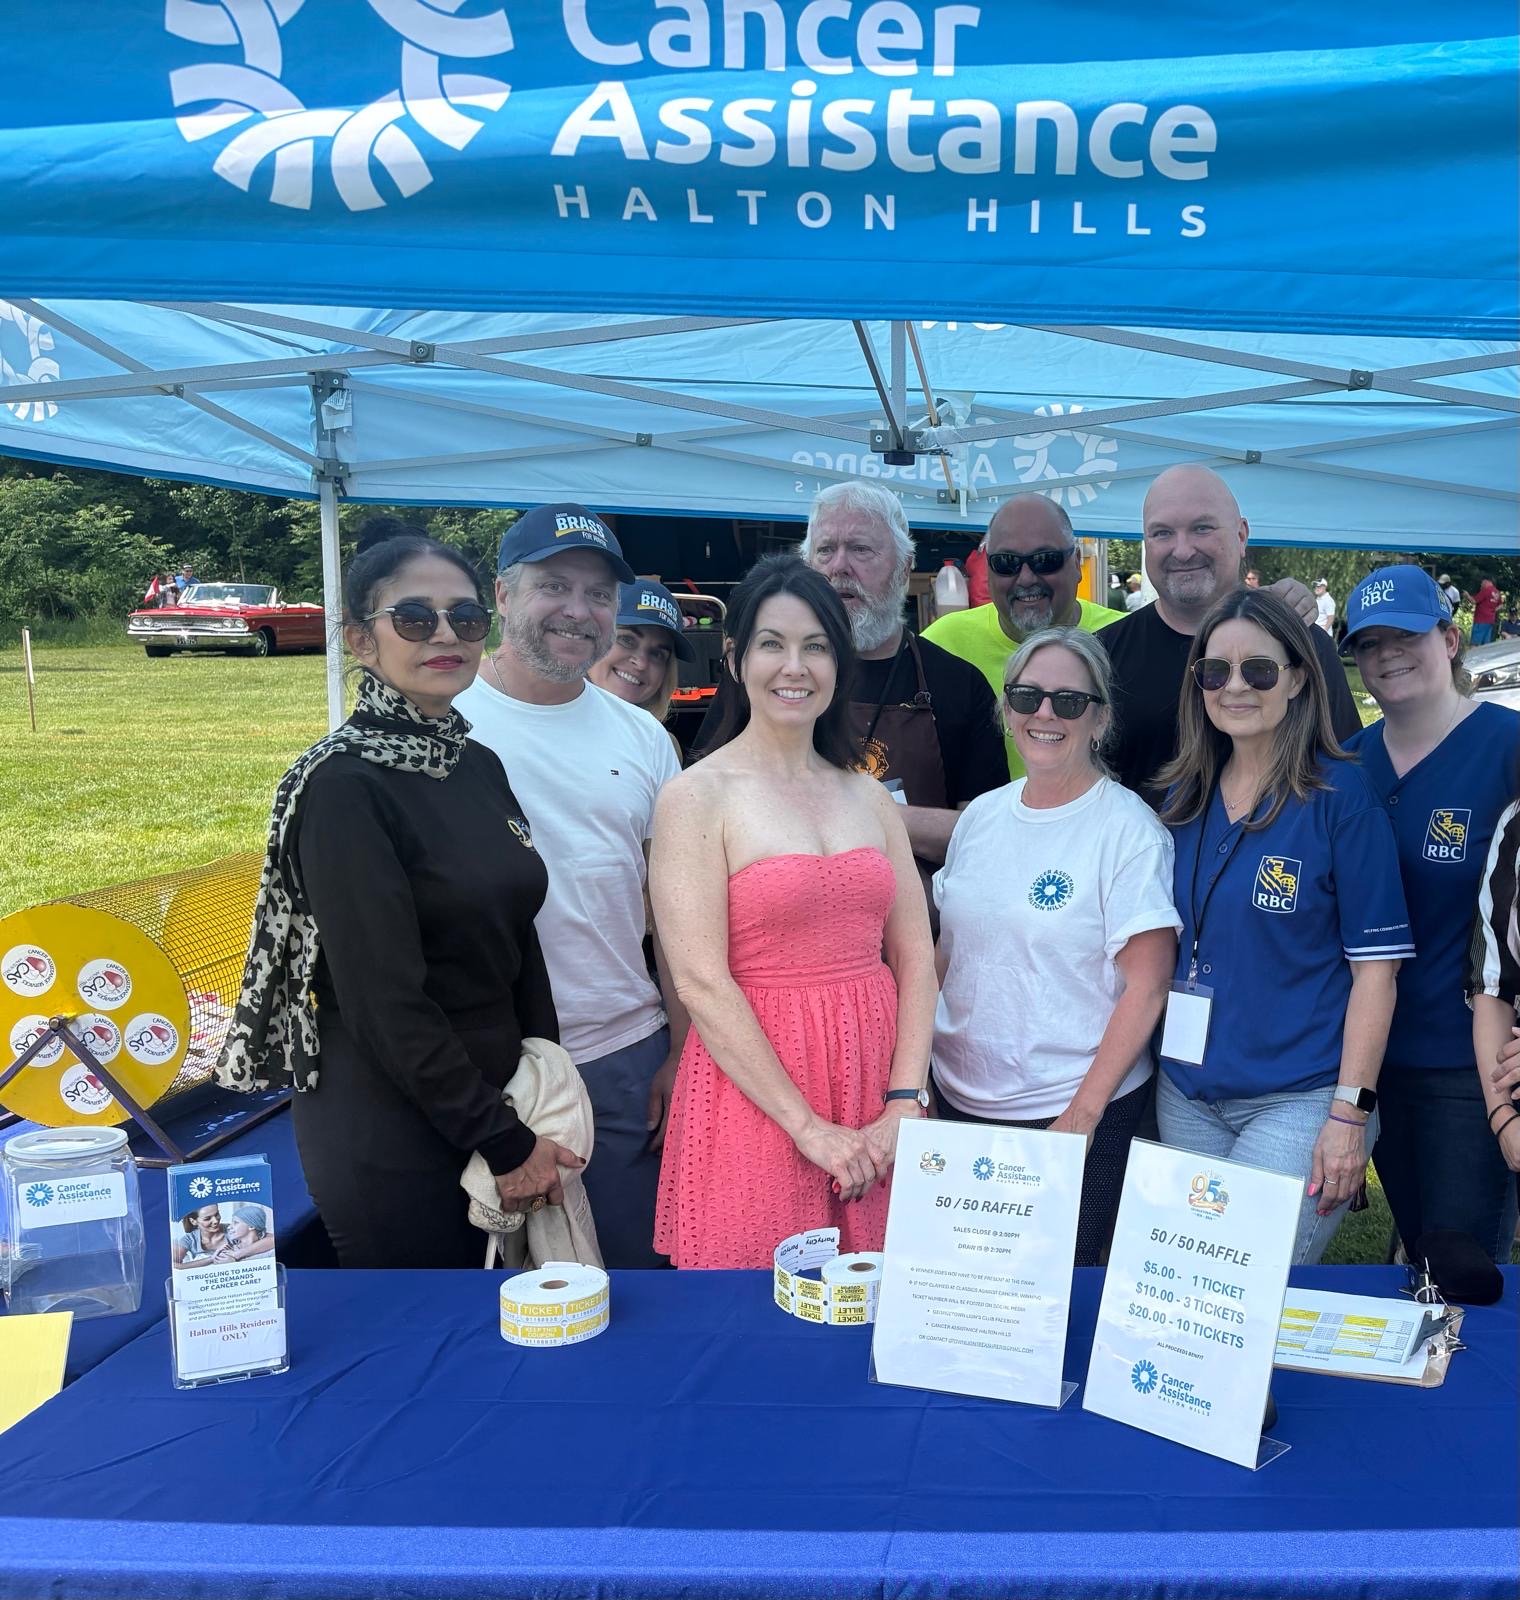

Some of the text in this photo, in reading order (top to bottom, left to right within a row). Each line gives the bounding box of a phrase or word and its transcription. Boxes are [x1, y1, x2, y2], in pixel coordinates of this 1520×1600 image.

[562, 0, 981, 77] Cancer
[550, 79, 1218, 181] Assistance
[554, 184, 1208, 239] HALTON HILLS
[556, 516, 605, 539] BRASS
[1361, 580, 1394, 597] TEAM
[641, 594, 678, 621] BRASS
[1361, 588, 1395, 611] RBC
[1427, 844, 1462, 860] RBC
[1046, 900, 1067, 911] HILLS
[1257, 892, 1292, 910] RBC
[6, 962, 30, 985] CAS
[82, 975, 106, 997] CAS
[80, 1031, 96, 1047] CA
[129, 1030, 153, 1052] CAS
[65, 1080, 89, 1102] CAS
[998, 1162, 1026, 1173] Cancer
[215, 1176, 244, 1186] Cancer
[996, 1171, 1041, 1183] Assistance
[57, 1182, 91, 1193] Cancer
[58, 1187, 112, 1201] Assistance
[215, 1181, 260, 1193] Assistance
[935, 1195, 1034, 1217] 50 / 50 RAFFLE
[972, 1228, 992, 1236] CLOSE
[958, 1243, 977, 1251] DRAW
[1150, 1228, 1252, 1267] 50 / 50 RAFFLE
[186, 1269, 231, 1282] STRUGGLING
[242, 1264, 271, 1274] MANAGE
[220, 1273, 254, 1284] DEMANDS
[1143, 1260, 1175, 1279] $5.00
[1193, 1275, 1198, 1287] 1
[1202, 1276, 1245, 1300] TICKET
[211, 1281, 239, 1291] CANCER
[523, 1306, 560, 1315] TICKET
[570, 1295, 600, 1313] TICKET
[800, 1301, 821, 1312] BILLET
[837, 1306, 864, 1314] BILLET
[1136, 1281, 1174, 1303] $10.00
[1183, 1296, 1191, 1308] 3
[1194, 1299, 1245, 1325] TICKETS
[800, 1310, 822, 1321] TICKET
[837, 1315, 865, 1323] TICKET
[190, 1318, 278, 1337] Halton Hills Residents
[1128, 1302, 1166, 1325] $20.00
[1177, 1318, 1190, 1332] 10
[1193, 1322, 1245, 1349] TICKETS
[222, 1331, 249, 1342] ONLY
[1165, 1343, 1188, 1356] PROCEEDS
[1161, 1373, 1195, 1392] Cancer
[1160, 1384, 1212, 1410] Assistance
